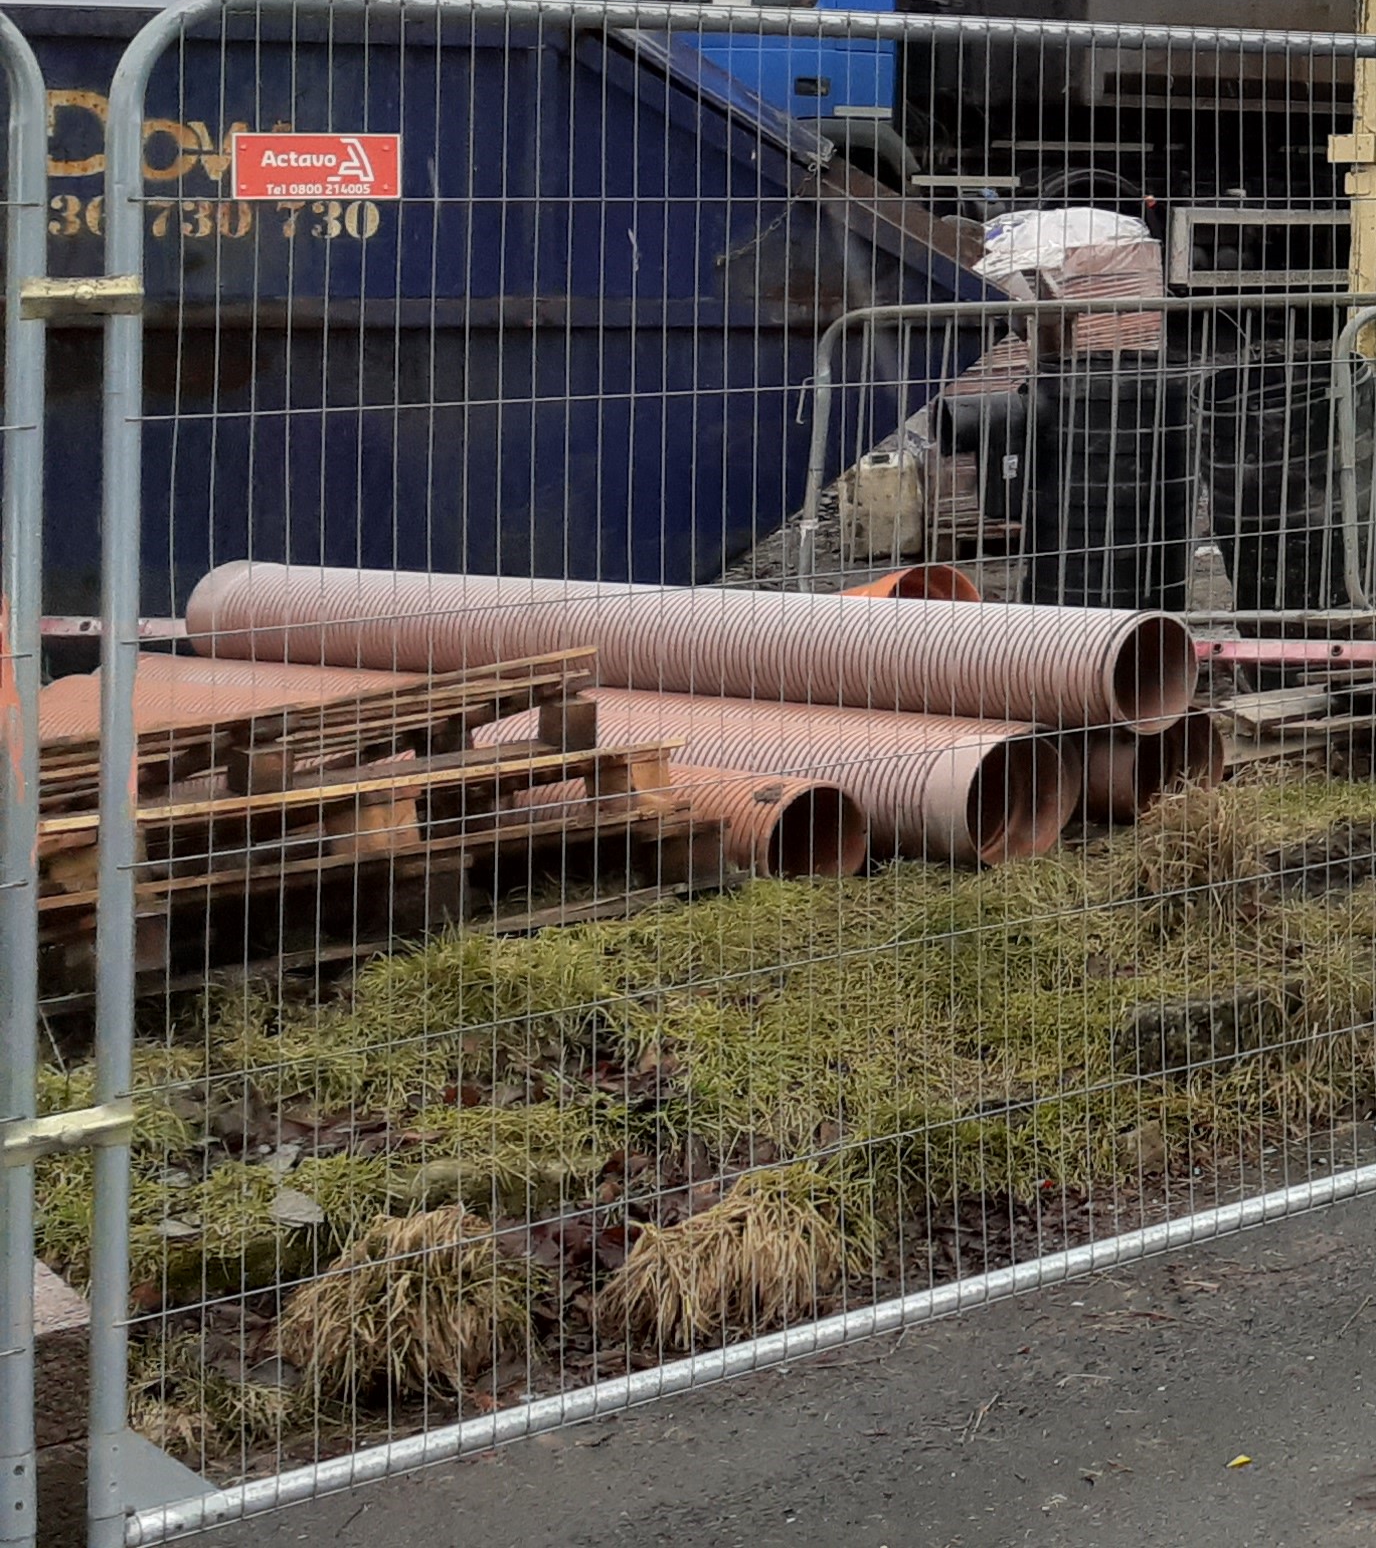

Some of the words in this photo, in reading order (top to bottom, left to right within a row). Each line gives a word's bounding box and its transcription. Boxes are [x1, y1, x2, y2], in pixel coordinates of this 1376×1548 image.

[261, 150, 337, 168] Actavo
[266, 184, 287, 195] Tel
[289, 184, 323, 195] 0800
[325, 183, 371, 195] 214005
